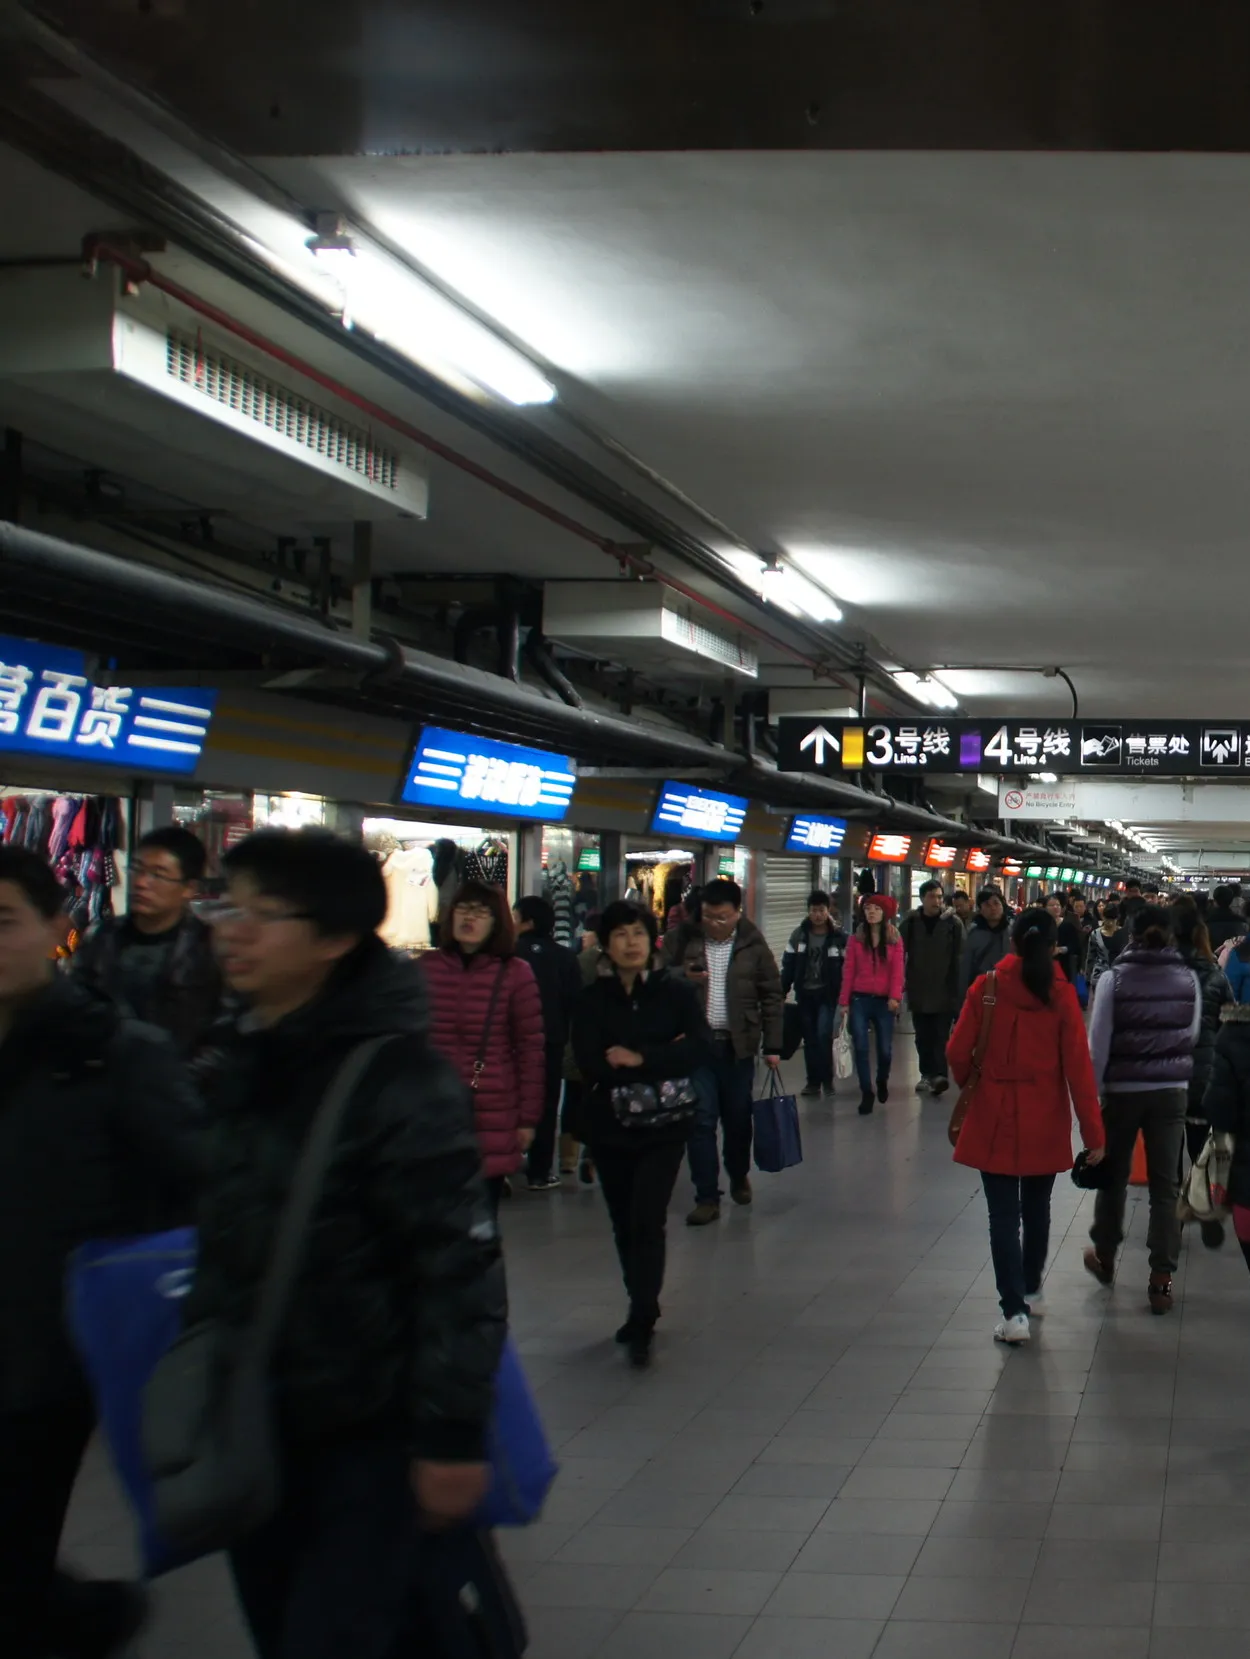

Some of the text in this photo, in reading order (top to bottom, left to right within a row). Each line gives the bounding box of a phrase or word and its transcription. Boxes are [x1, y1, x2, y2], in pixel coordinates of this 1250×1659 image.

[866, 725, 950, 765] 3号线
[984, 725, 1071, 765] 4号线
[1126, 733, 1190, 755] 售票处
[894, 753, 928, 765] Line 3
[1014, 753, 1047, 765] Line 4
[1126, 756, 1159, 766] Tickets
